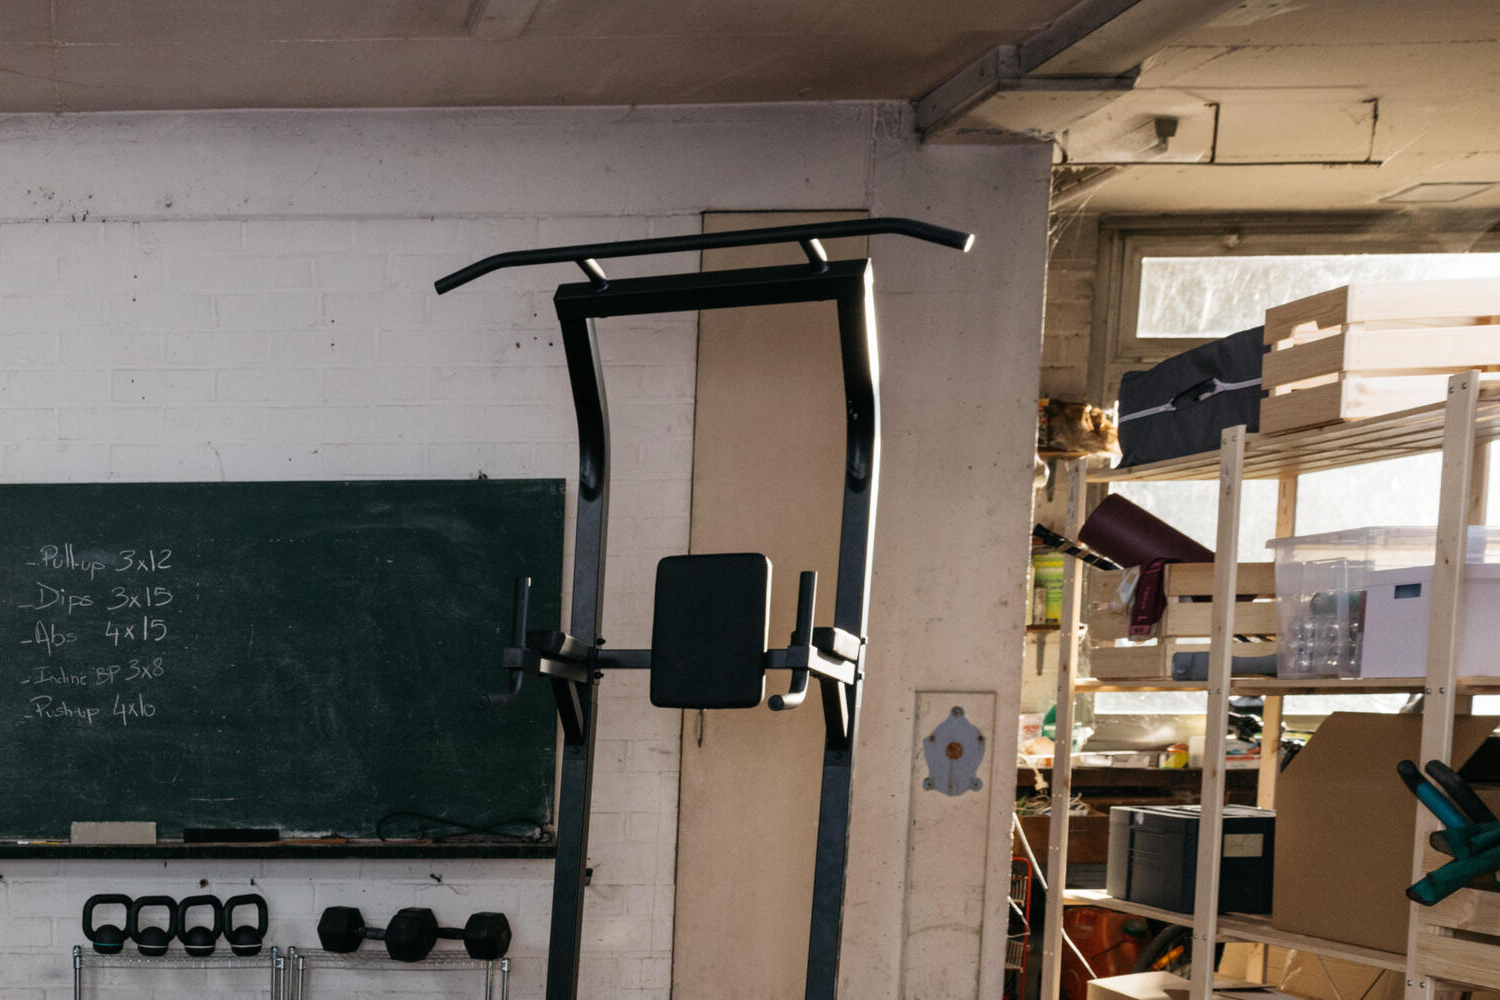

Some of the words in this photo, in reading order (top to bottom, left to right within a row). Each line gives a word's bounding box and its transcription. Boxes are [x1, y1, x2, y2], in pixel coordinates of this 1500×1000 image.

[115, 549, 172, 572] 3x12
[34, 581, 94, 614] Dips
[34, 620, 78, 656] Abs
[92, 665, 121, 686] BP
[125, 657, 165, 681] 3x8
